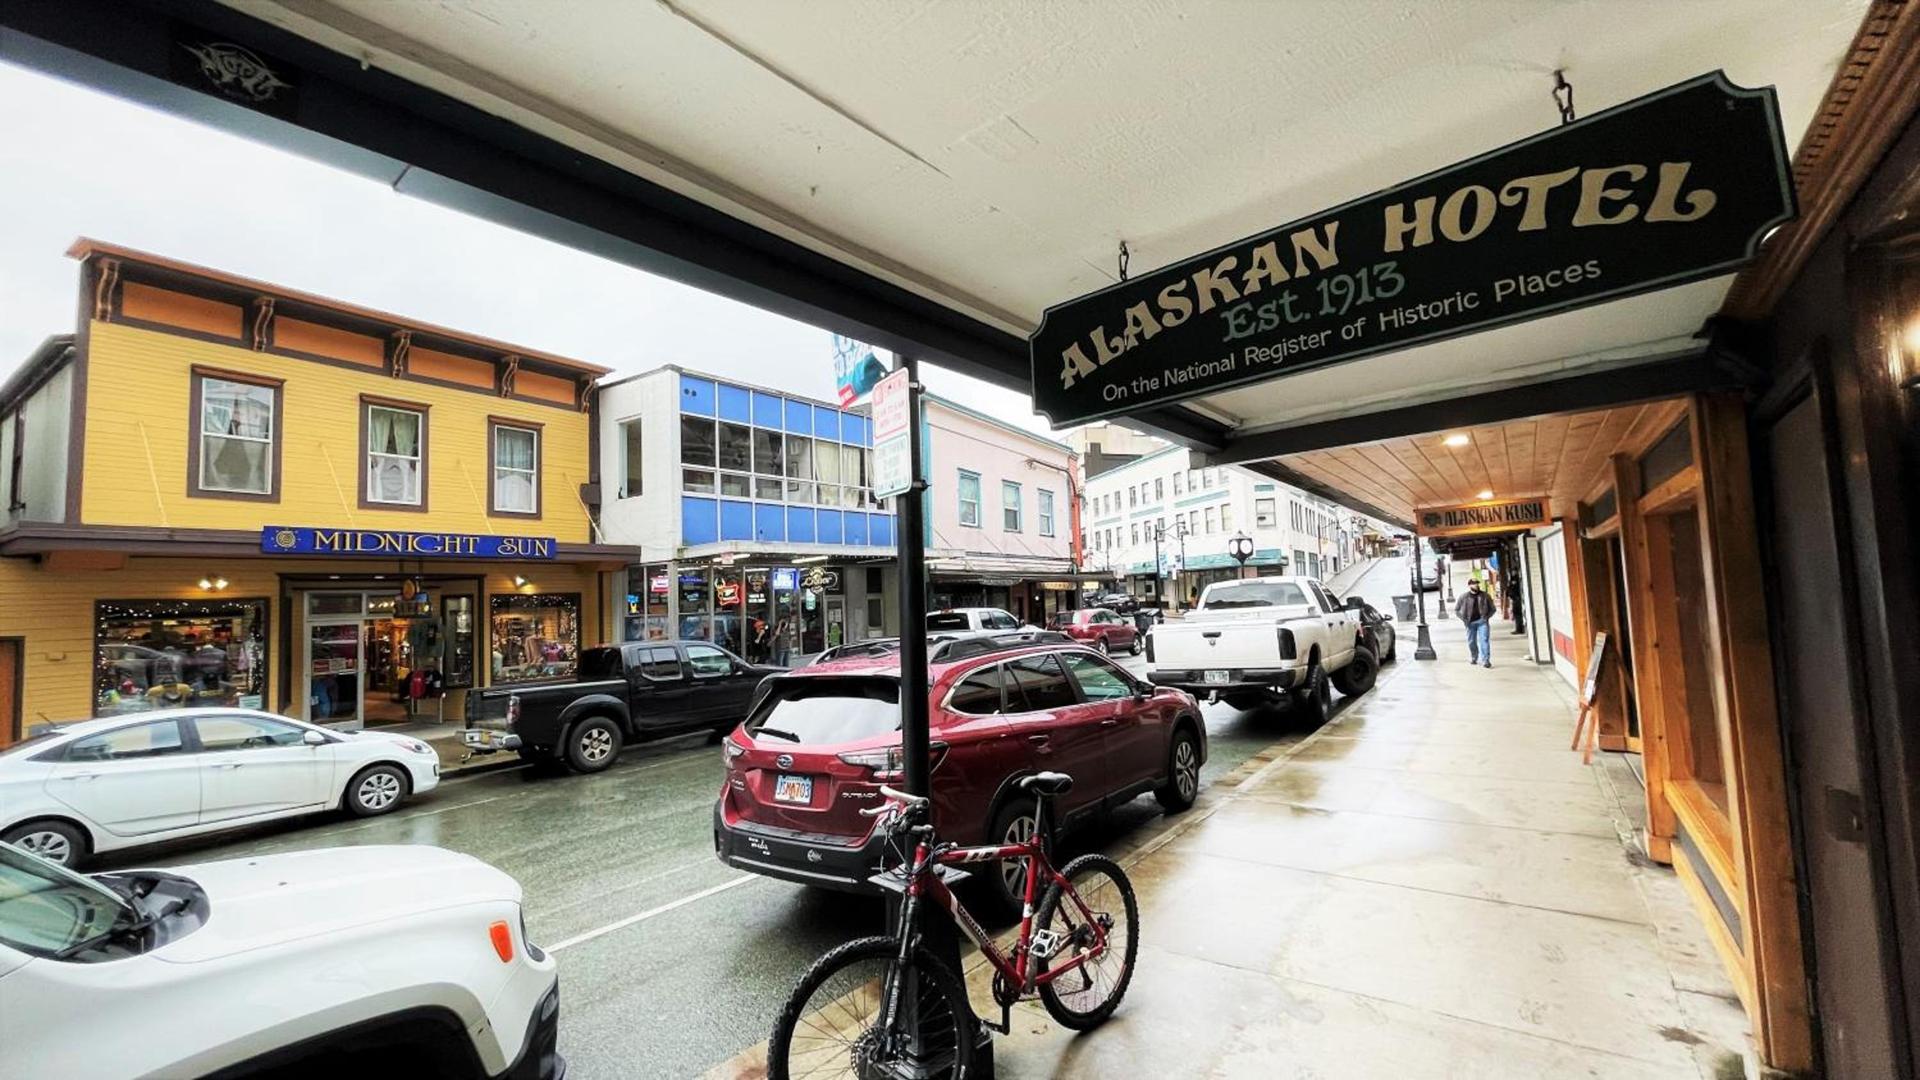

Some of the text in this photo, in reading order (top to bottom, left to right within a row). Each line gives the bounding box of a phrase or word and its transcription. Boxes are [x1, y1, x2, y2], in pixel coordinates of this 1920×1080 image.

[1060, 161, 1717, 390] ALASKAN HOTEL
[1219, 260, 1406, 343] Est. 1913
[1102, 259, 1602, 402] On the National Register of Historic Places
[313, 530, 549, 557] MIDNIGHT SUN
[1445, 502, 1543, 526] ALASKAN KUSH
